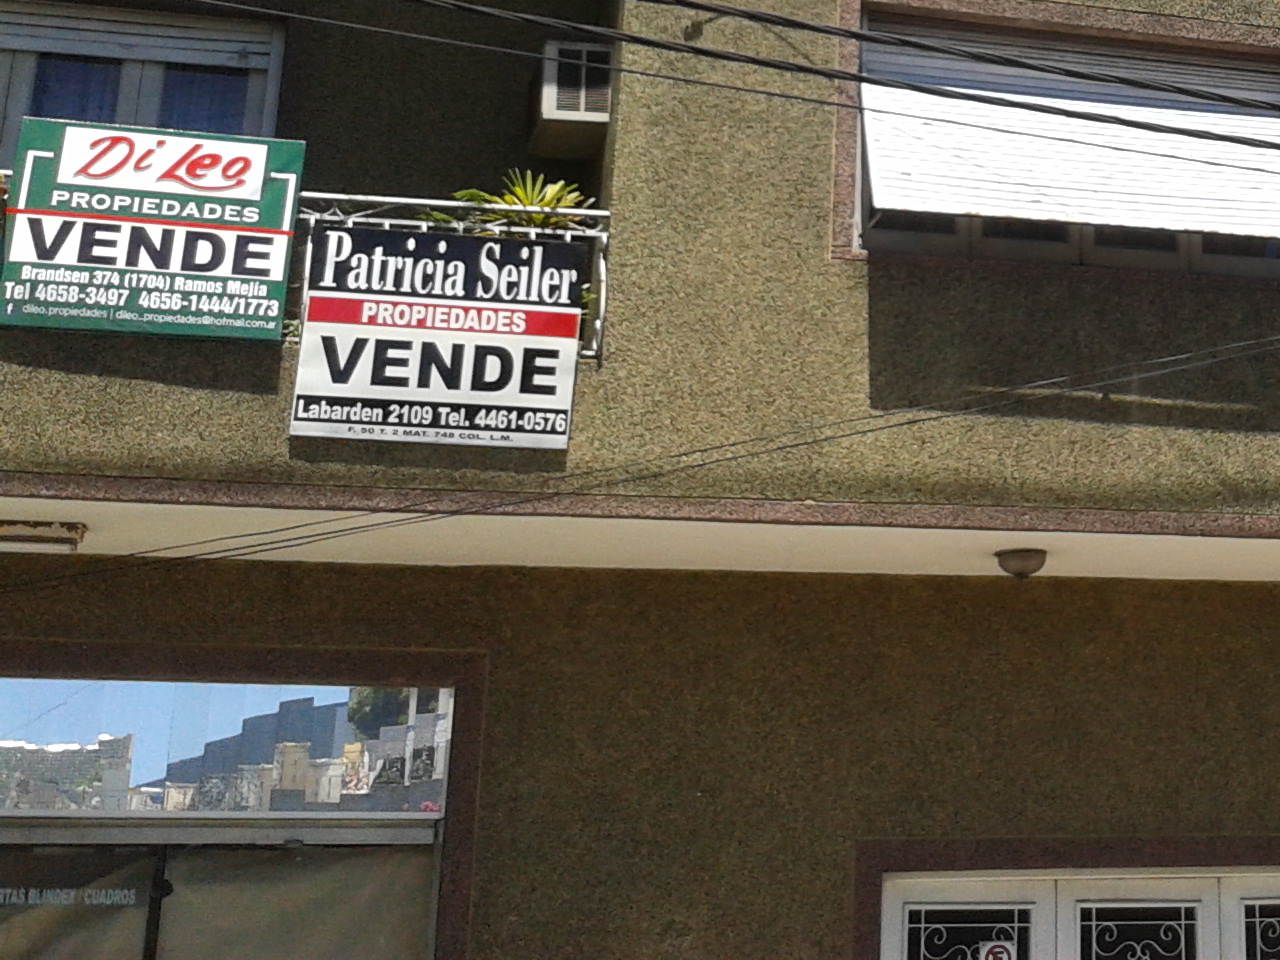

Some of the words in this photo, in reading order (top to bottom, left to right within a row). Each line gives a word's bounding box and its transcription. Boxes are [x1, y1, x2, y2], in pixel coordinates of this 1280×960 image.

[73, 135, 166, 180] Di
[156, 143, 252, 191] Leo
[51, 190, 260, 223] PROPIEDADES
[27, 217, 275, 277] VENDE
[22, 265, 90, 284] Brandsen
[93, 270, 120, 286] 374
[124, 273, 171, 291] (1704)
[174, 276, 224, 294] Ramos
[319, 230, 465, 297] Patricia
[476, 241, 578, 304] Seiler
[4, 281, 31, 300] Tel
[35, 283, 130, 306] 4658-3497
[138, 291, 280, 317] 4656-1444/1773
[361, 302, 527, 333] PROPIEDADES
[320, 335, 560, 396] VENDE
[297, 399, 384, 422] Labarden
[387, 404, 433, 425] 2109
[438, 407, 470, 427] Tel.
[474, 408, 567, 432] 4461-0576
